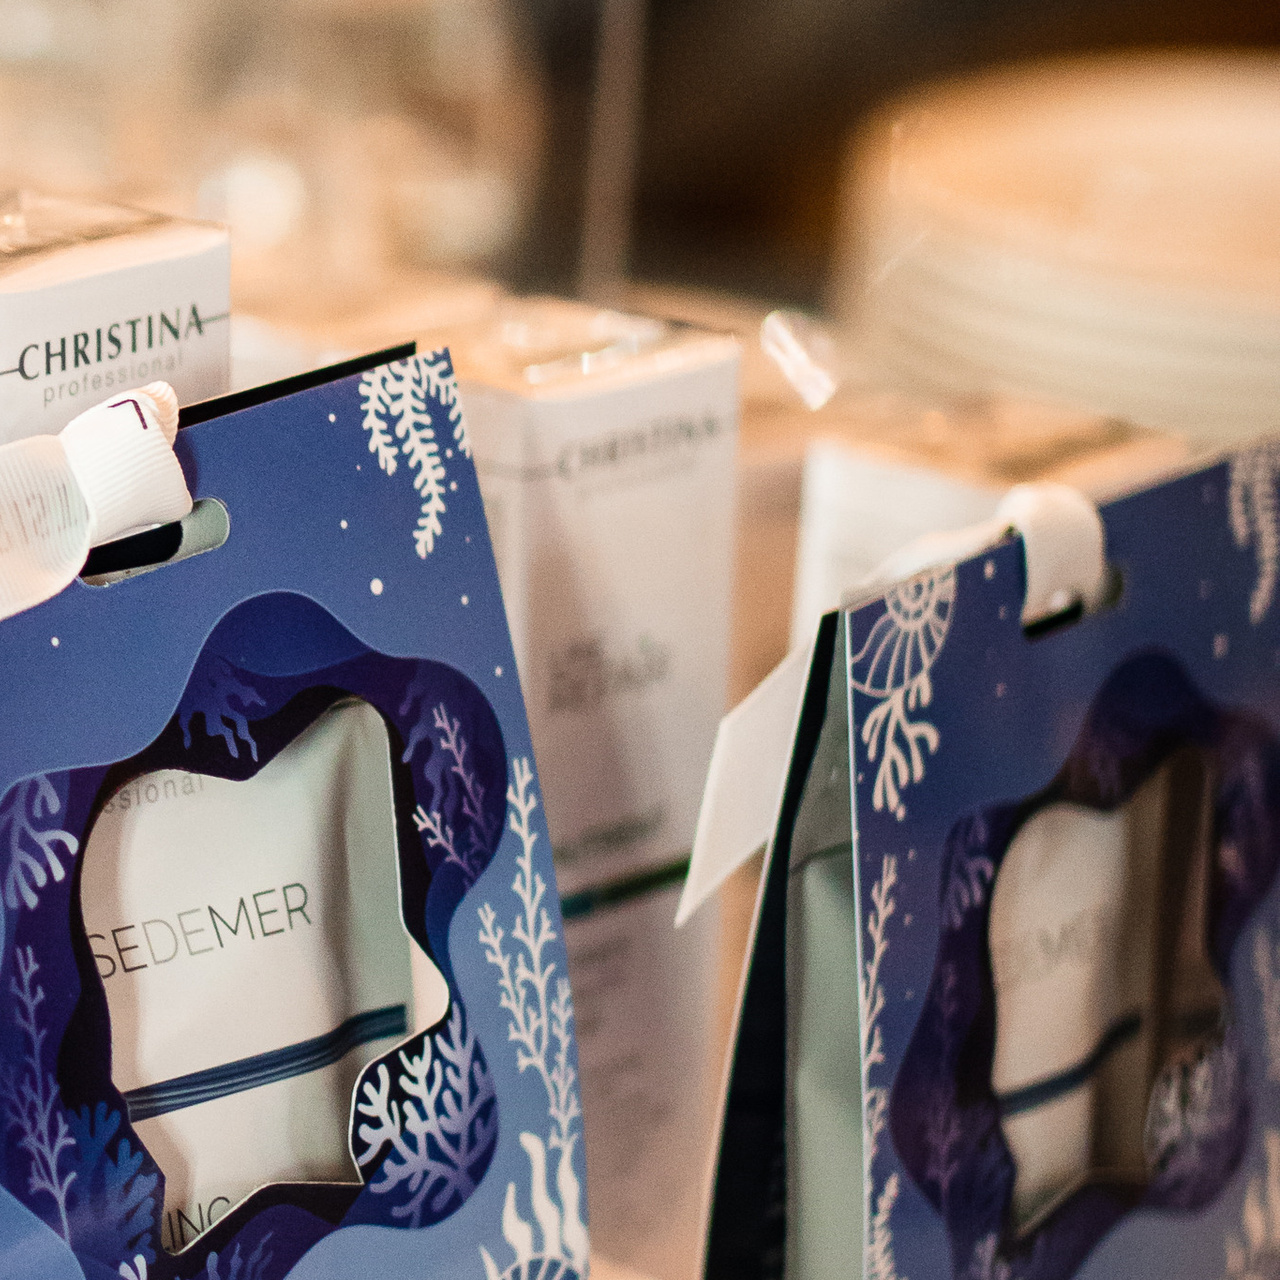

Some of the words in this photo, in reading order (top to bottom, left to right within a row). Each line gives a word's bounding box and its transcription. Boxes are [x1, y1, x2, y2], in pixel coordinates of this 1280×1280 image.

[19, 304, 204, 381] CHRISTINA
[43, 350, 183, 408] professional
[88, 882, 312, 980] SEDEMER
